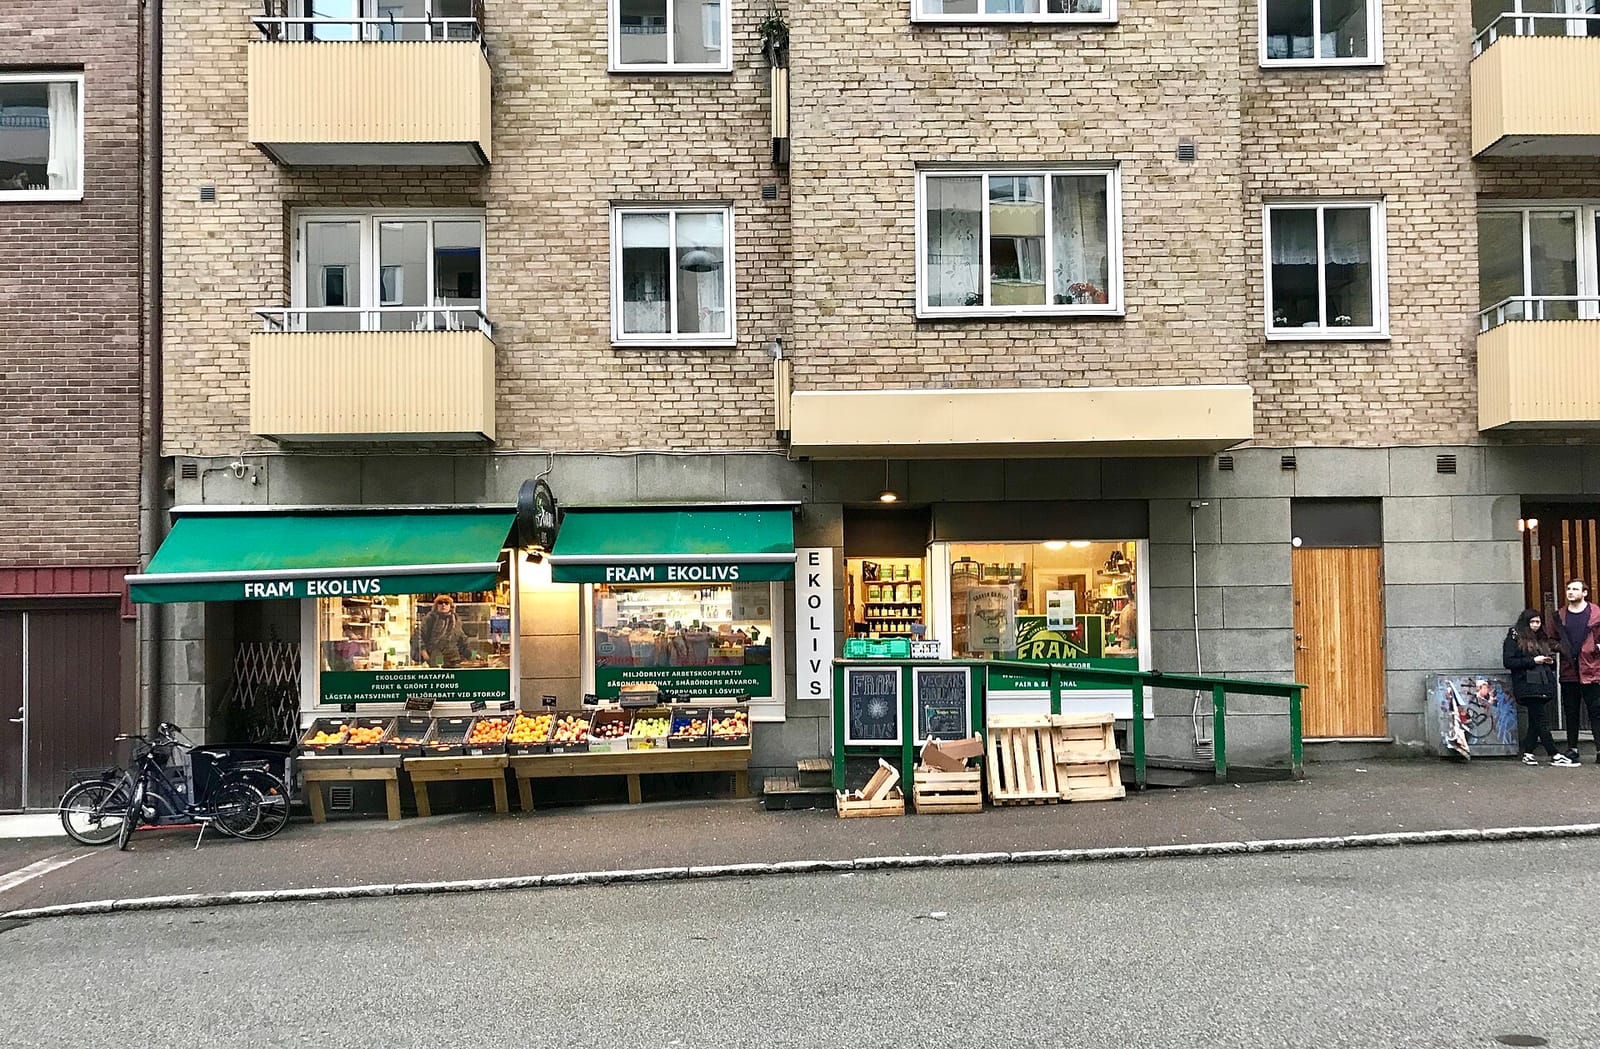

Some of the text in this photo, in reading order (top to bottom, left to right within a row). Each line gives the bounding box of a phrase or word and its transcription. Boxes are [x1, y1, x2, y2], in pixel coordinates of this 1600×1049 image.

[606, 565, 740, 581] FRAM EKOLIVS
[244, 578, 381, 598] FRAM EKOLIVS
[808, 552, 822, 695] EKOLIVS
[1017, 641, 1077, 660] FRAM
[403, 682, 429, 690] GRÖNT
[724, 678, 760, 686] RÅVAROR,
[852, 674, 897, 696] FRAM
[324, 692, 353, 700] LÄGSTA
[353, 692, 400, 700] MATSVINNET
[472, 690, 506, 698] STORKÖP
